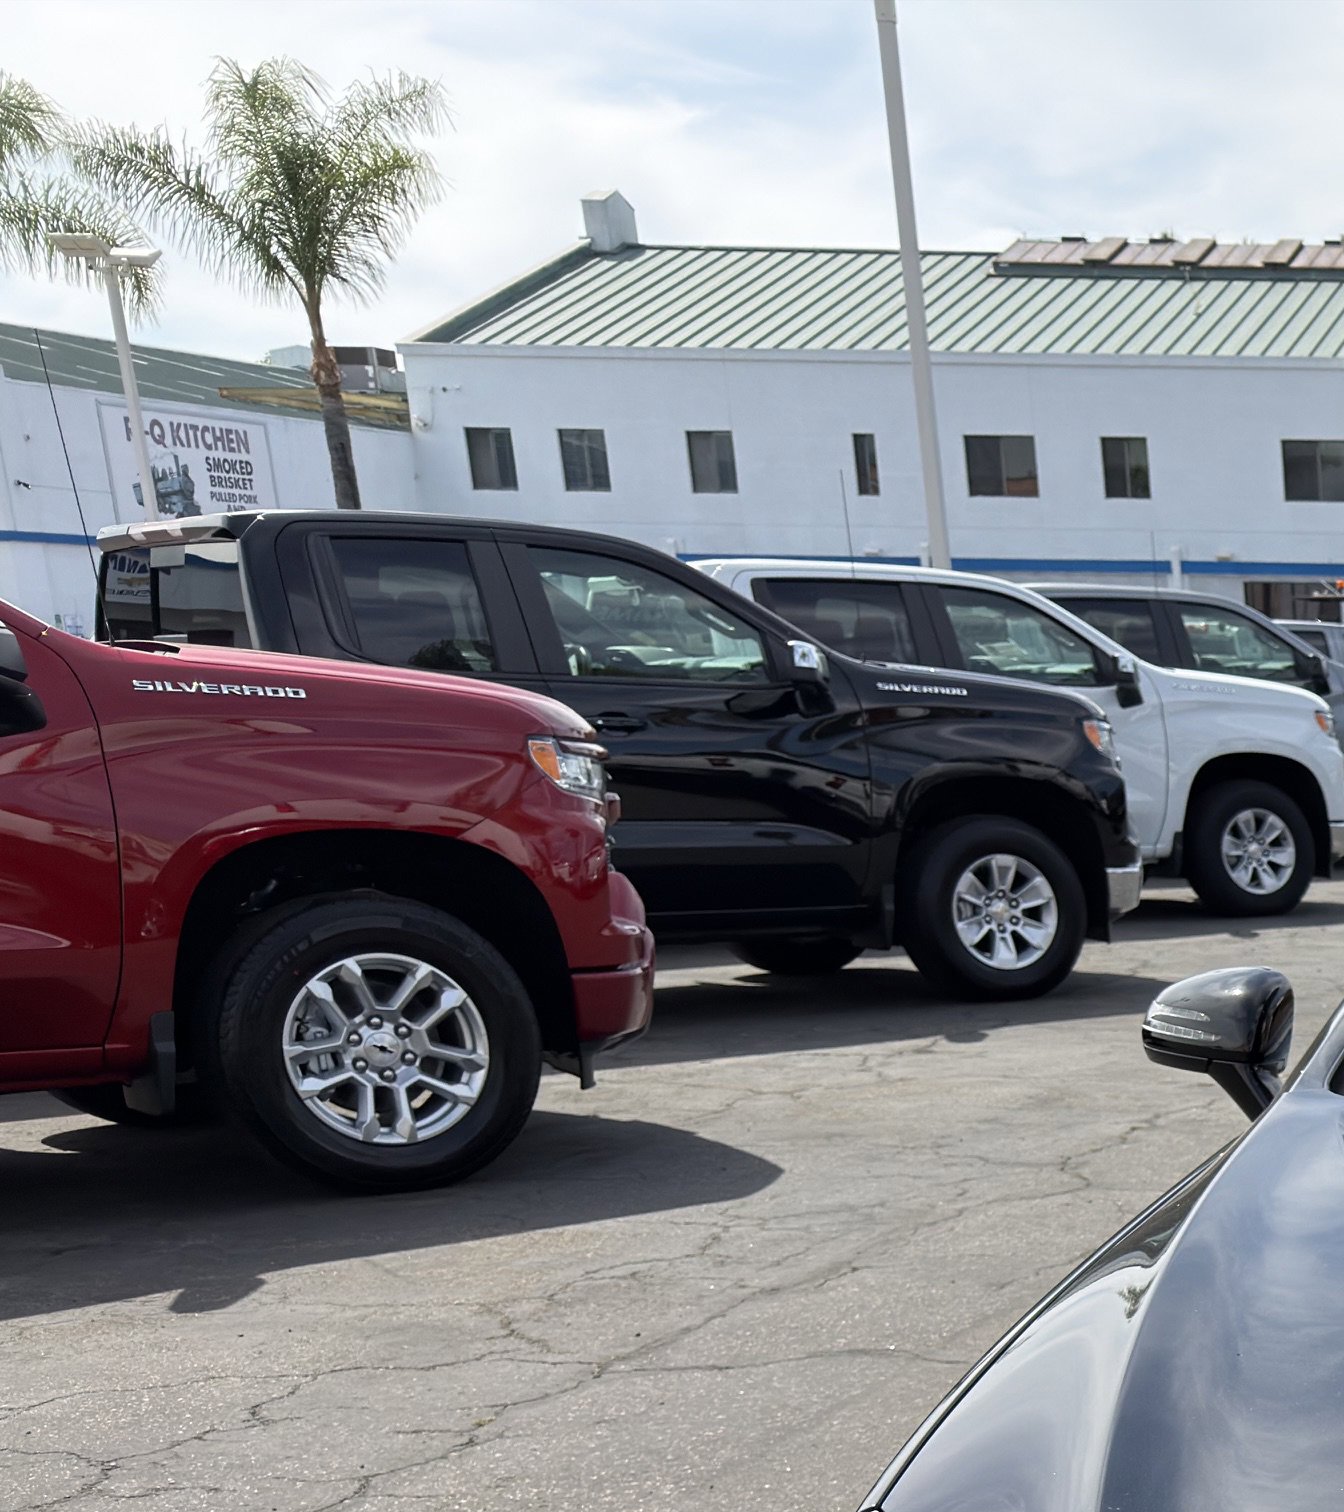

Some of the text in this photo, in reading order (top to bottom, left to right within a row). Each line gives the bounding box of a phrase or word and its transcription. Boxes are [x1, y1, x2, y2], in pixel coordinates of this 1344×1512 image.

[169, 421, 251, 455] KITCHEN
[205, 455, 254, 476] SMOKED
[209, 474, 254, 491] BRISKET
[210, 490, 258, 505] PULLED PORK
[132, 679, 307, 699] SILVERADO
[876, 682, 968, 696] SILVERADO
